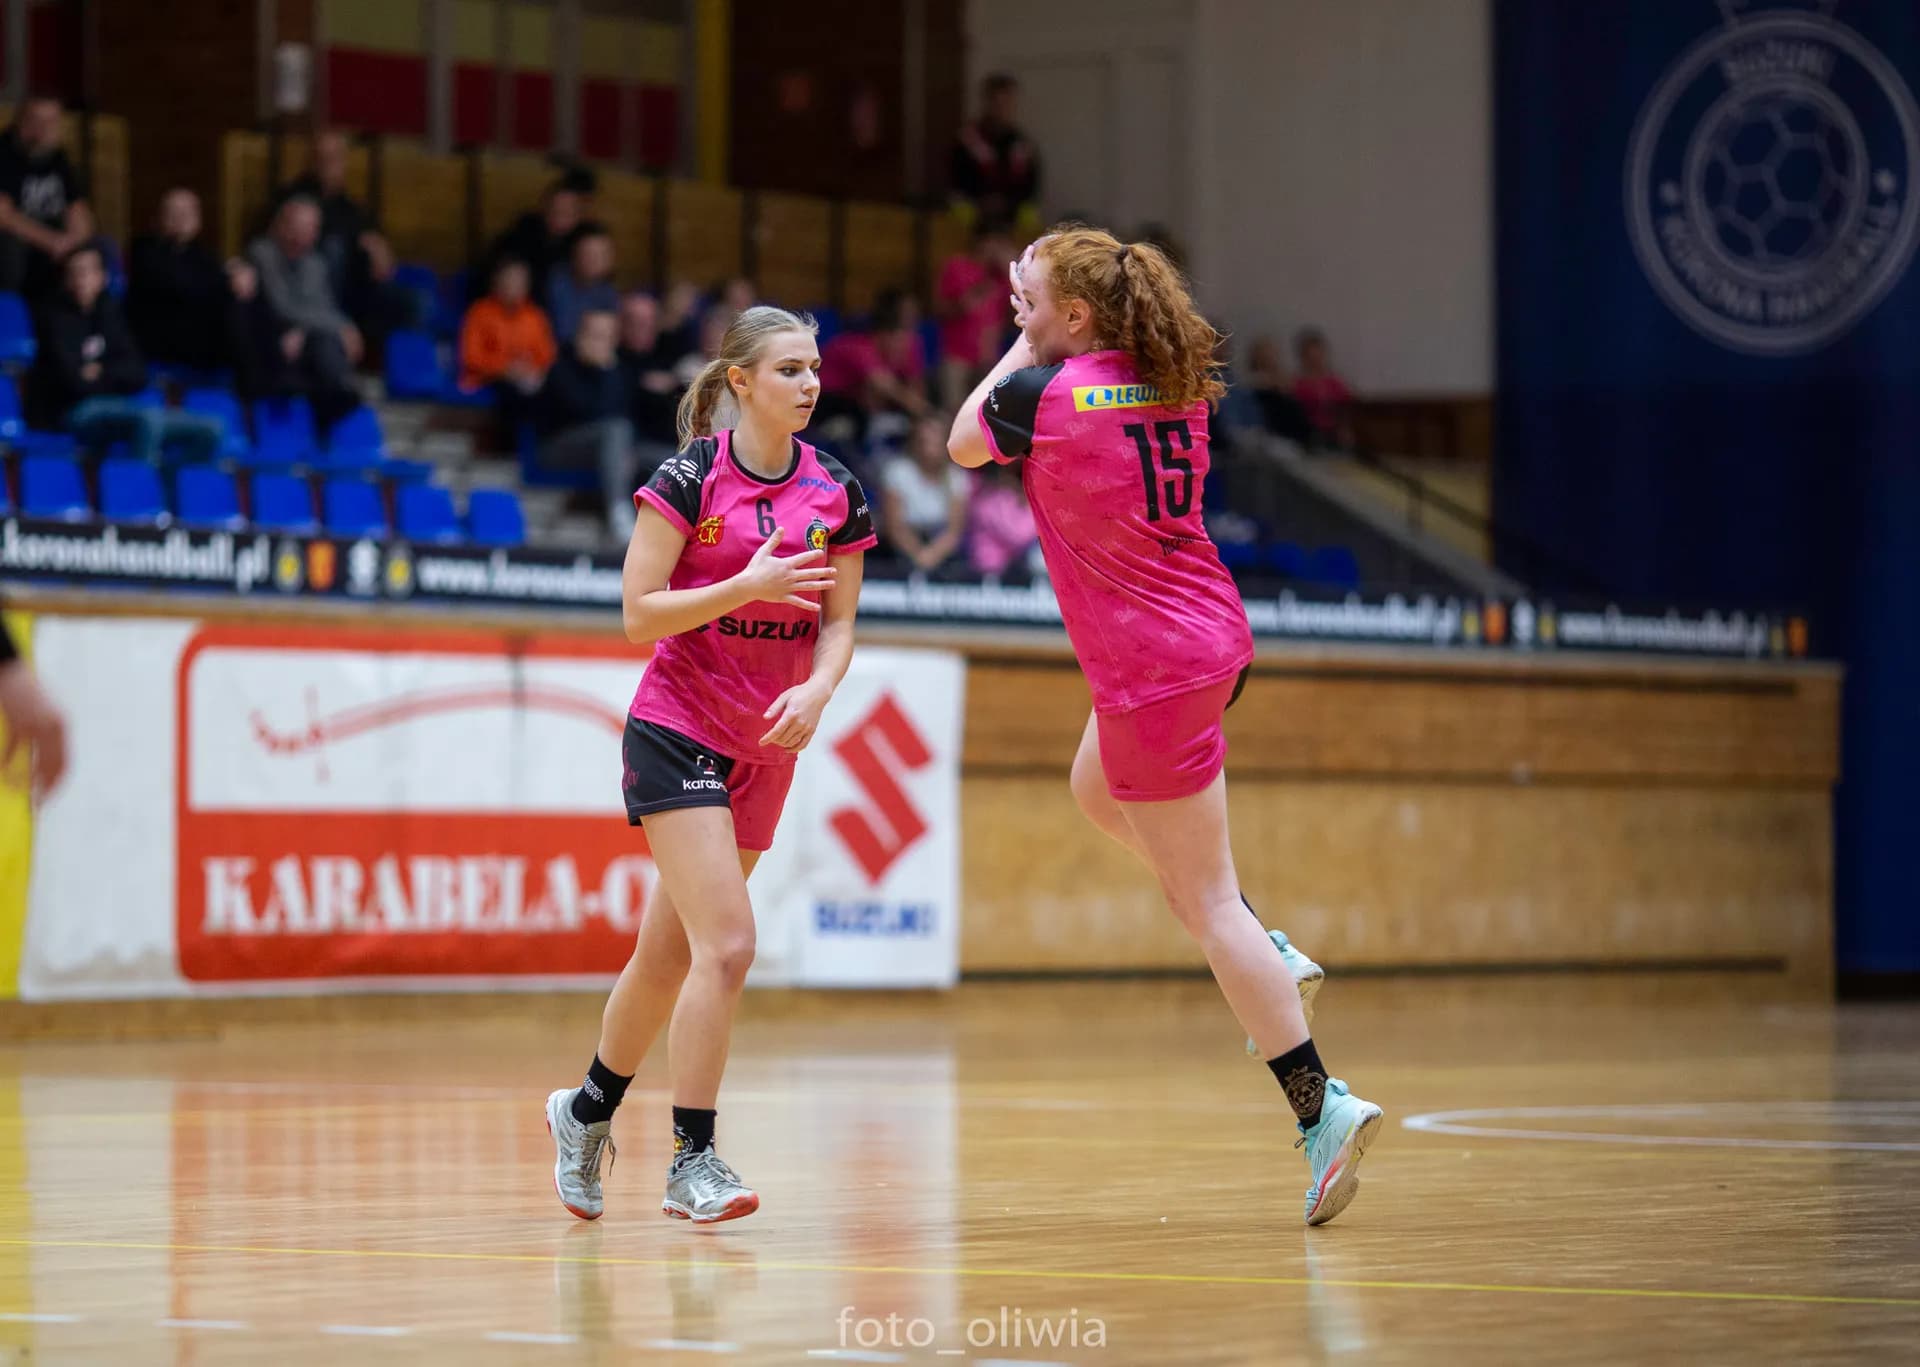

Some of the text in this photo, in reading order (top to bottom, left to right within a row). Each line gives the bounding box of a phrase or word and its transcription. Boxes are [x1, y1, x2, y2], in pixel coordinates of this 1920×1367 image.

[1116, 383, 1161, 405] LEWI
[1123, 418, 1194, 522] 15
[755, 497, 777, 538] 6
